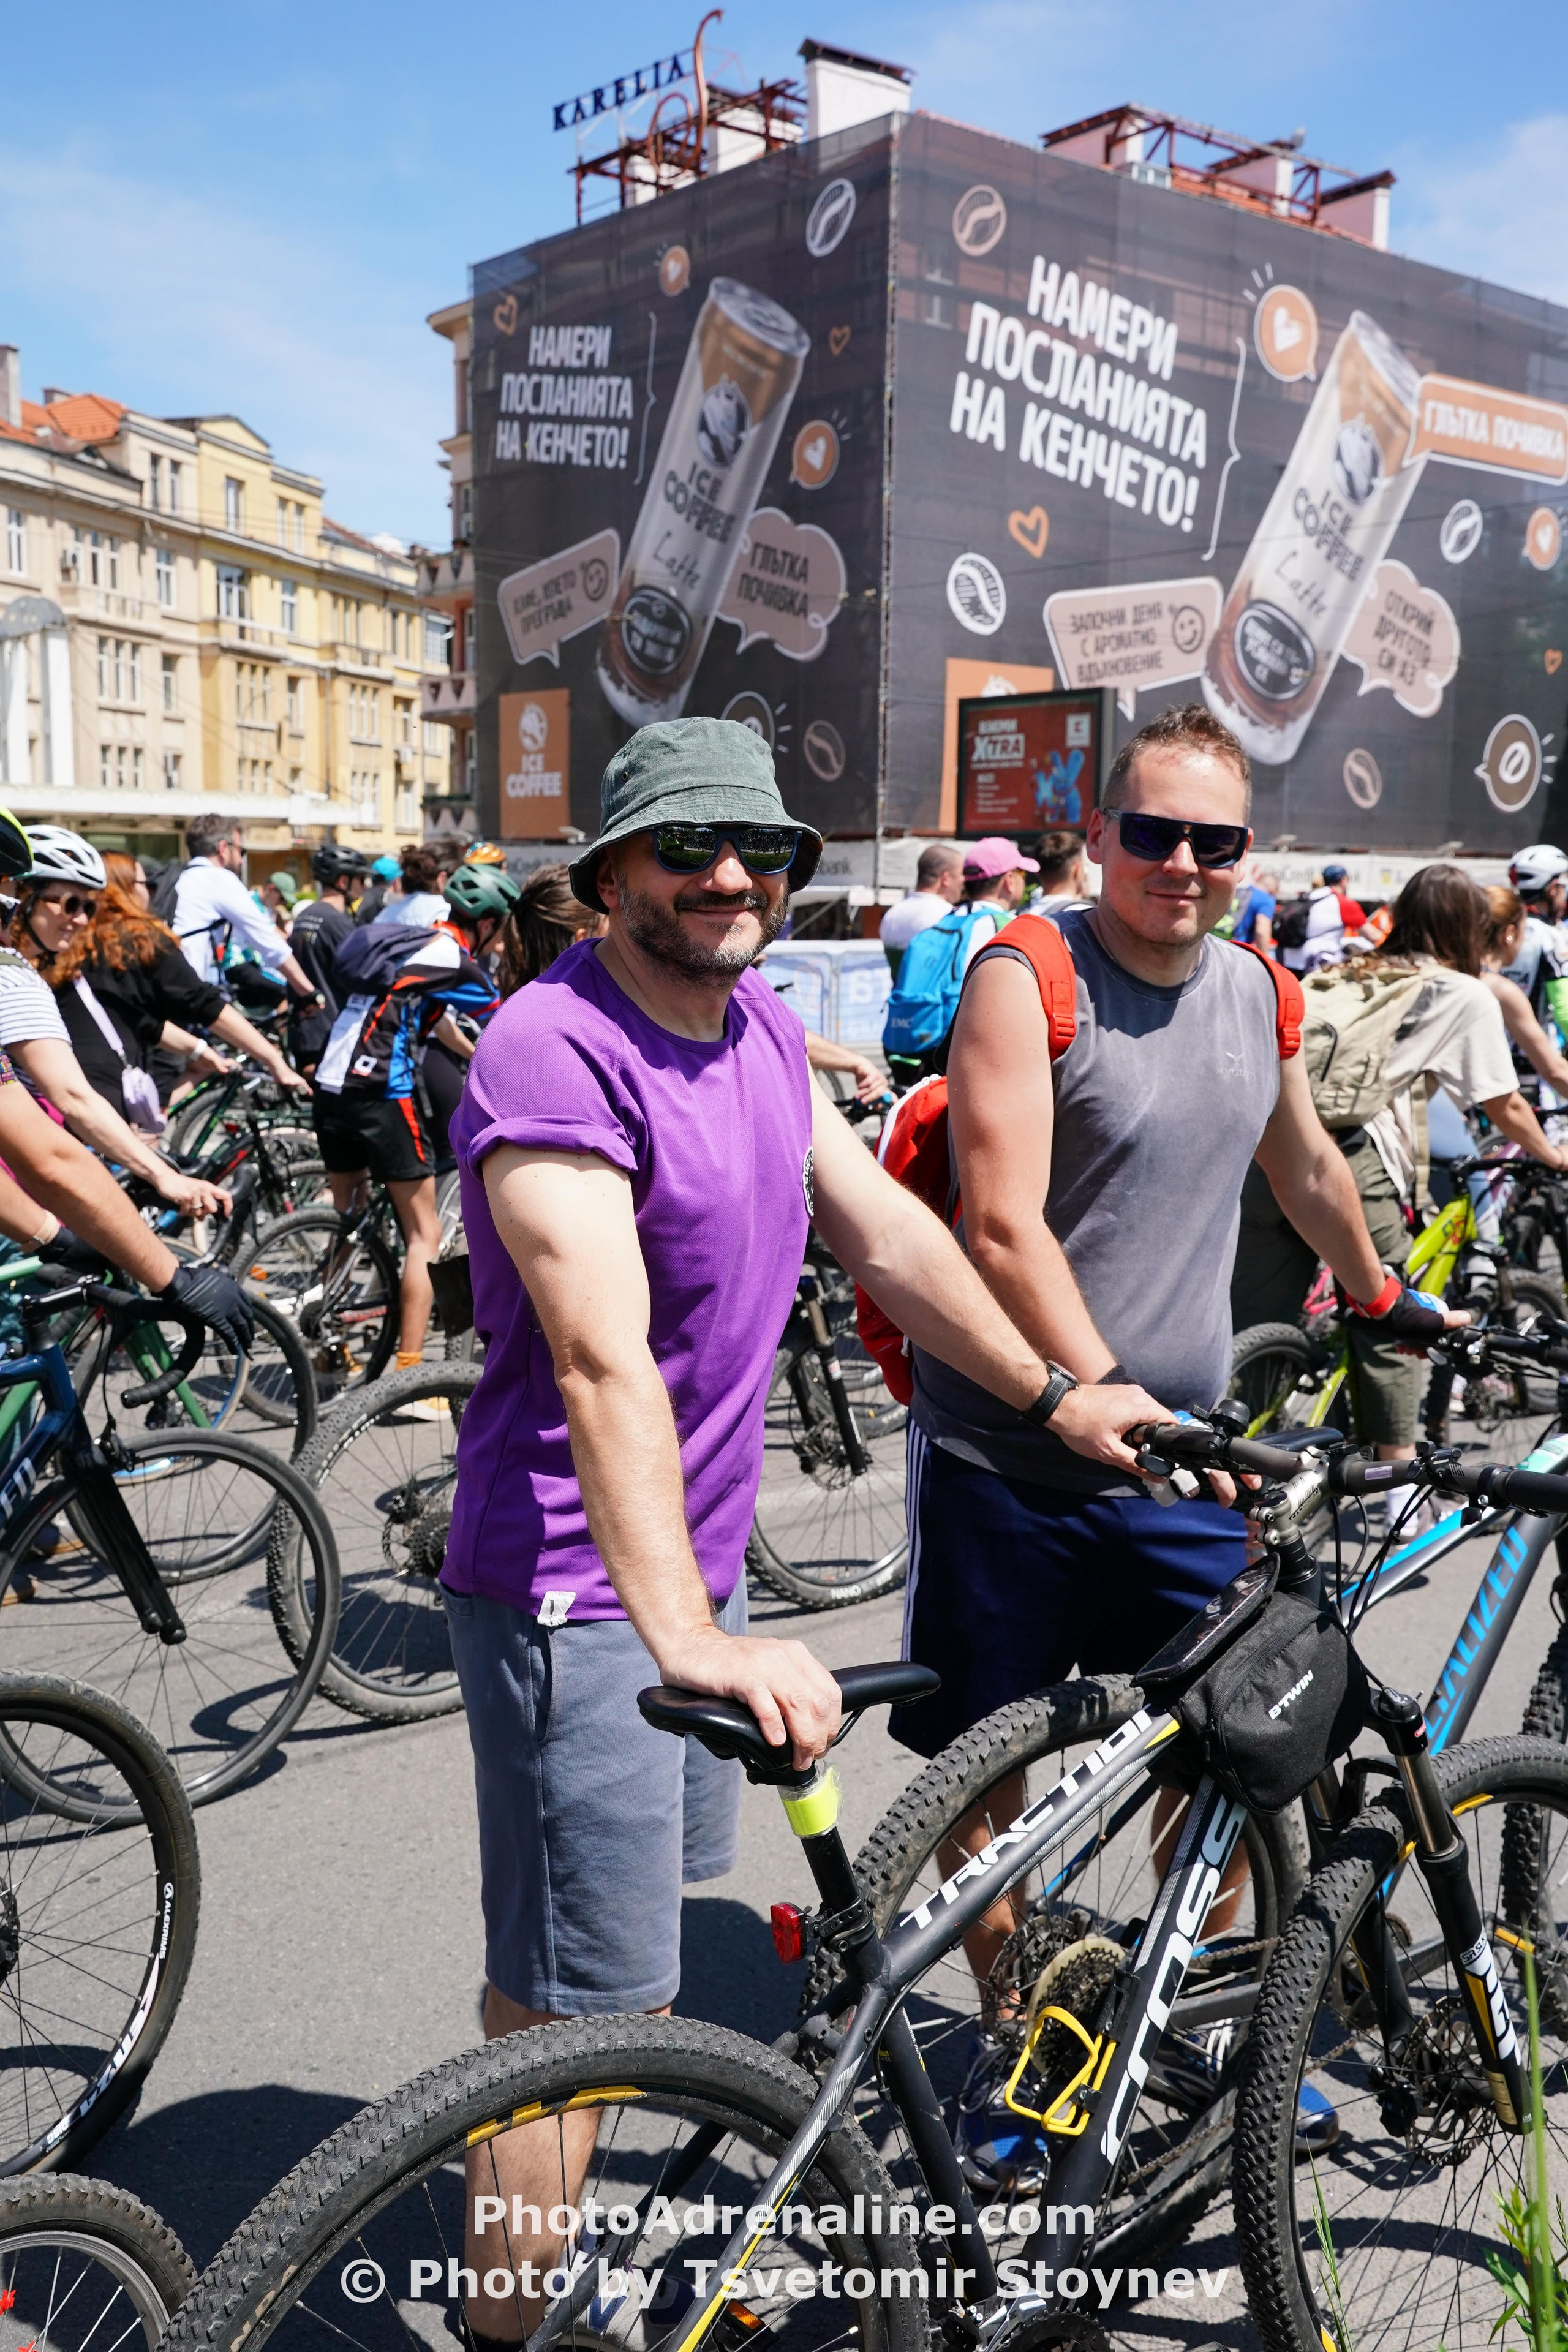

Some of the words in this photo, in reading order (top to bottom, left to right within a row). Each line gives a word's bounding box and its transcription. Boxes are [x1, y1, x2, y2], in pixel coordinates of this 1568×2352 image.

[553, 54, 685, 132] KARELIA
[1027, 255, 1178, 381] НАМЕРИ
[528, 325, 612, 369] НАМЕРИ
[500, 372, 633, 420] ПОСЛАНИЯТА
[965, 301, 1207, 469] ПОСЛАНИЯТА
[496, 419, 521, 461] НА
[526, 421, 630, 470] КЕНЧЕТО!
[950, 371, 1006, 452] НА
[1019, 402, 1200, 533] КЕНЧЕТО!
[1423, 399, 1490, 445] ГЛЪТКА
[1492, 414, 1566, 463] ПОЧИВКА
[688, 461, 723, 503] ICE
[664, 470, 736, 543] COFFEE
[1321, 491, 1352, 535] ICE
[1294, 488, 1364, 581] COFFEE
[652, 530, 701, 589] Latte
[750, 541, 809, 584] ГЛЪТКА
[1275, 550, 1327, 617] Latte
[737, 572, 809, 620] ПОЧИВКА
[1071, 606, 1126, 635] ЗАПОЧНИ
[1133, 601, 1162, 625] ДЕНЯ
[1384, 590, 1435, 636] ОТКРИЙ
[1094, 627, 1156, 655] АРОМАТНО
[1374, 615, 1431, 669] ДРУГОТО
[1379, 647, 1397, 673] СИ
[1077, 650, 1163, 684] ВДЪХНОВЕНИЕ
[506, 771, 562, 797] COFFEE
[521, 753, 545, 772] ICE
[160, 1900, 173, 1959] ALEXRIMS
